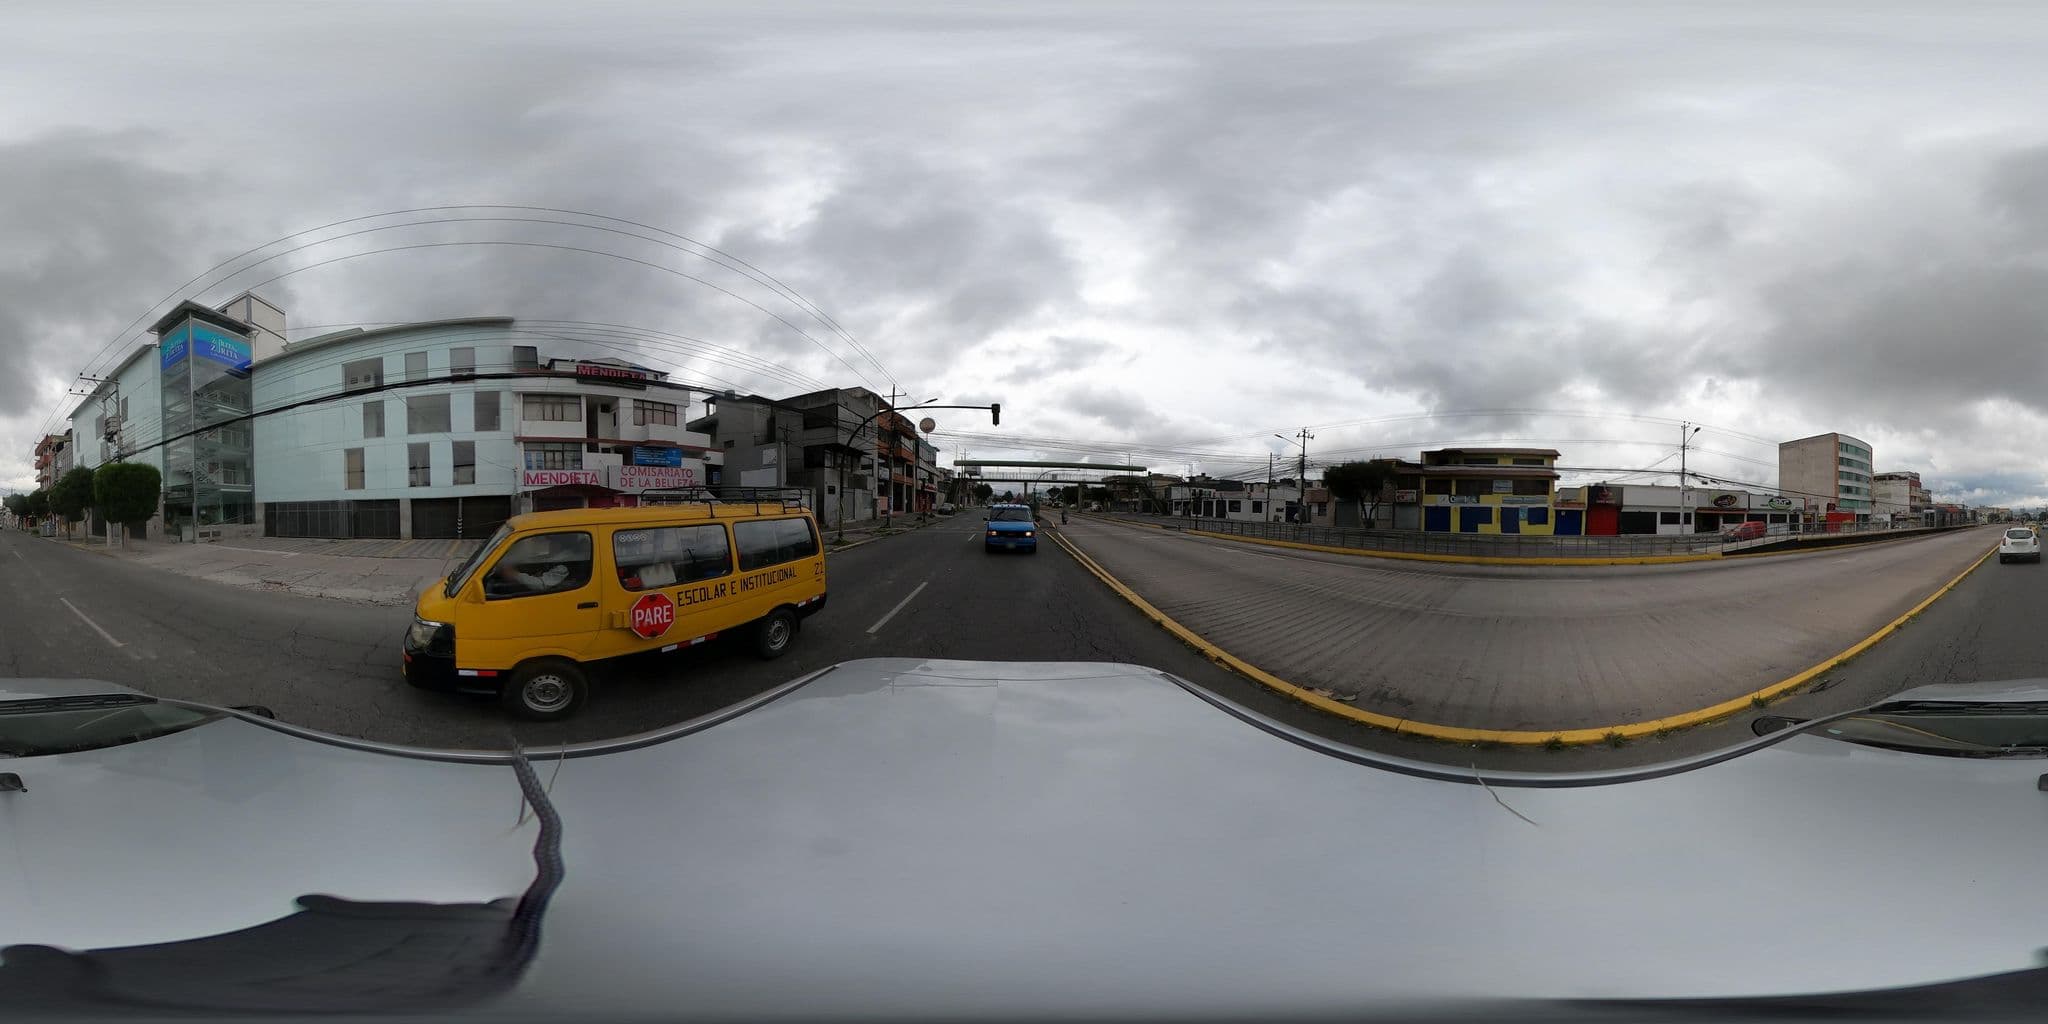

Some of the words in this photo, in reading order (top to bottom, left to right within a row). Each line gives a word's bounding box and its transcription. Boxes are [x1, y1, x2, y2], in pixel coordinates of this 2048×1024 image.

[578, 366, 646, 380] MENDIETA
[526, 472, 599, 485] MENDIETA
[620, 466, 694, 478] COMISARIATO
[620, 478, 634, 488] DE
[638, 478, 652, 488] LA
[655, 479, 695, 488] BELLEZA
[677, 583, 727, 608] ESCOLAR
[730, 581, 737, 596] E
[740, 567, 798, 592] INSTITUCIONAL
[635, 605, 673, 625] PARE
